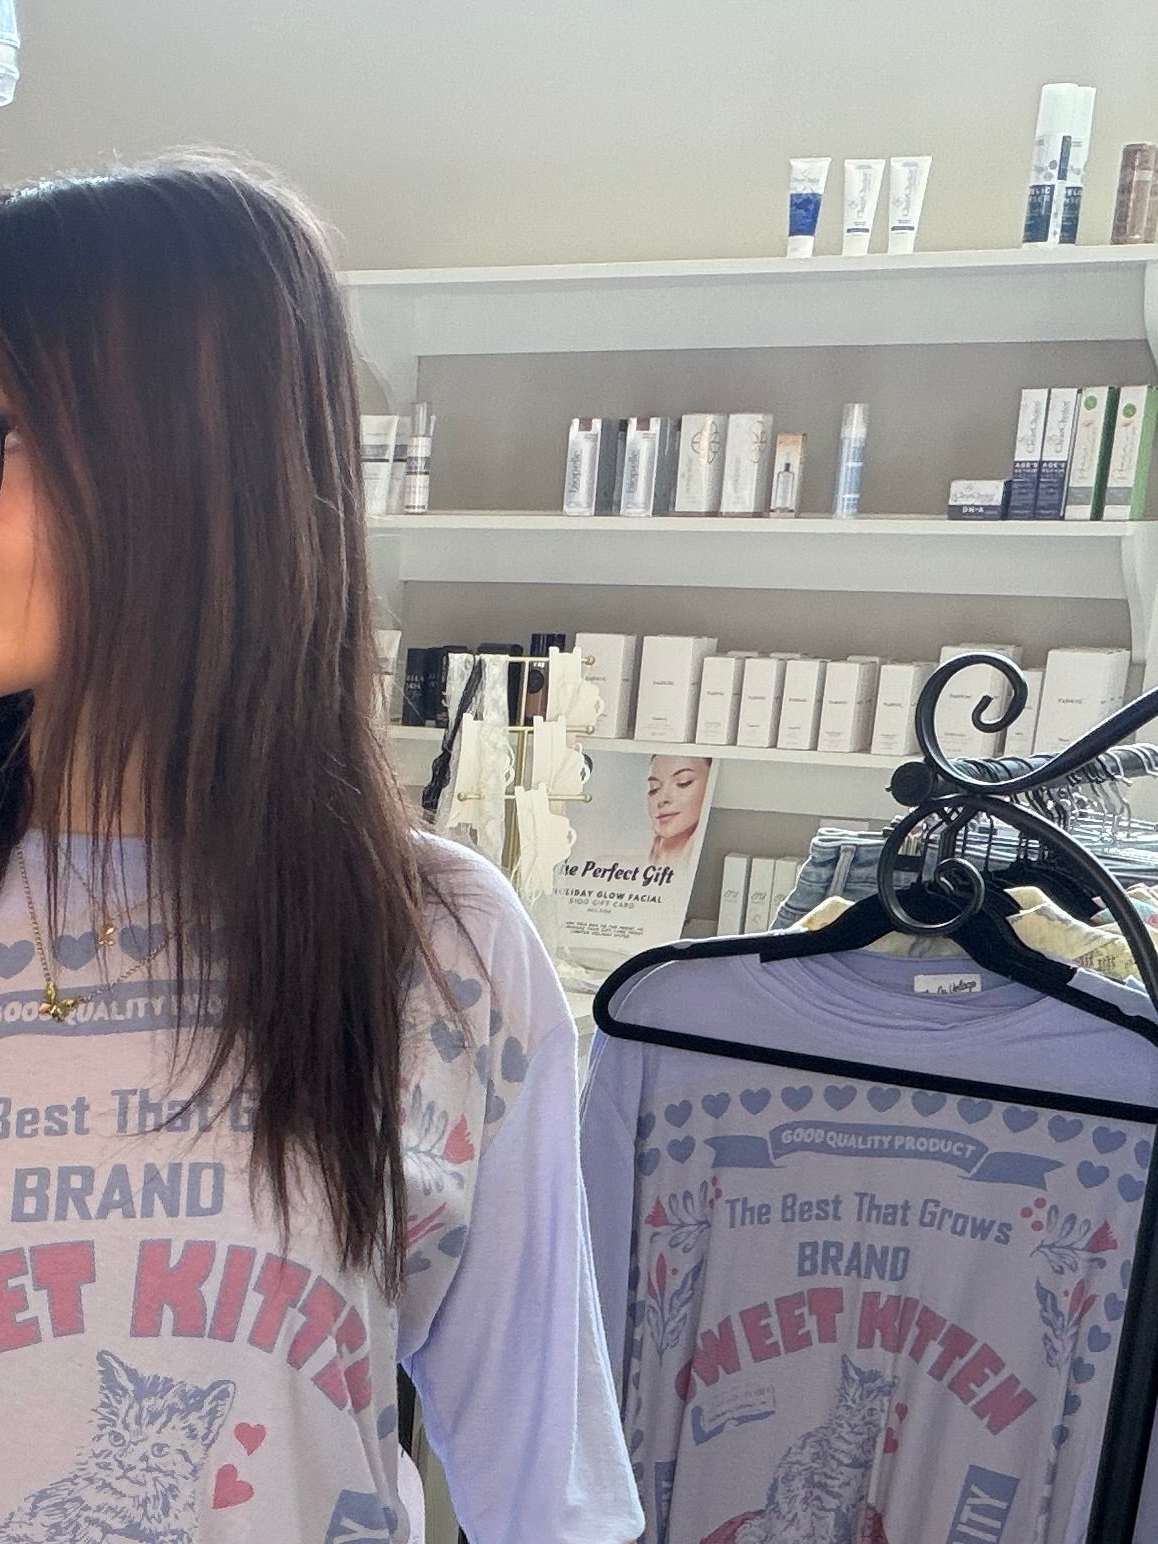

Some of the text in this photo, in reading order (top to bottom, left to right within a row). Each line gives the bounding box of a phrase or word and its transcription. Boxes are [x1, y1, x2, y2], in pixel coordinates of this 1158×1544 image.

[581, 860, 640, 882] Perfect
[642, 865, 674, 886] Gift
[596, 890, 625, 900] GLOW
[628, 893, 662, 904] FACIAL
[781, 1127, 977, 1160] GOOD QUALITY PRODUCT
[10, 1161, 226, 1223] BRAND
[725, 1190, 1013, 1247] The Best That Grows
[797, 1239, 911, 1283] BRAND
[855, 1290, 1037, 1436] KITTEN
